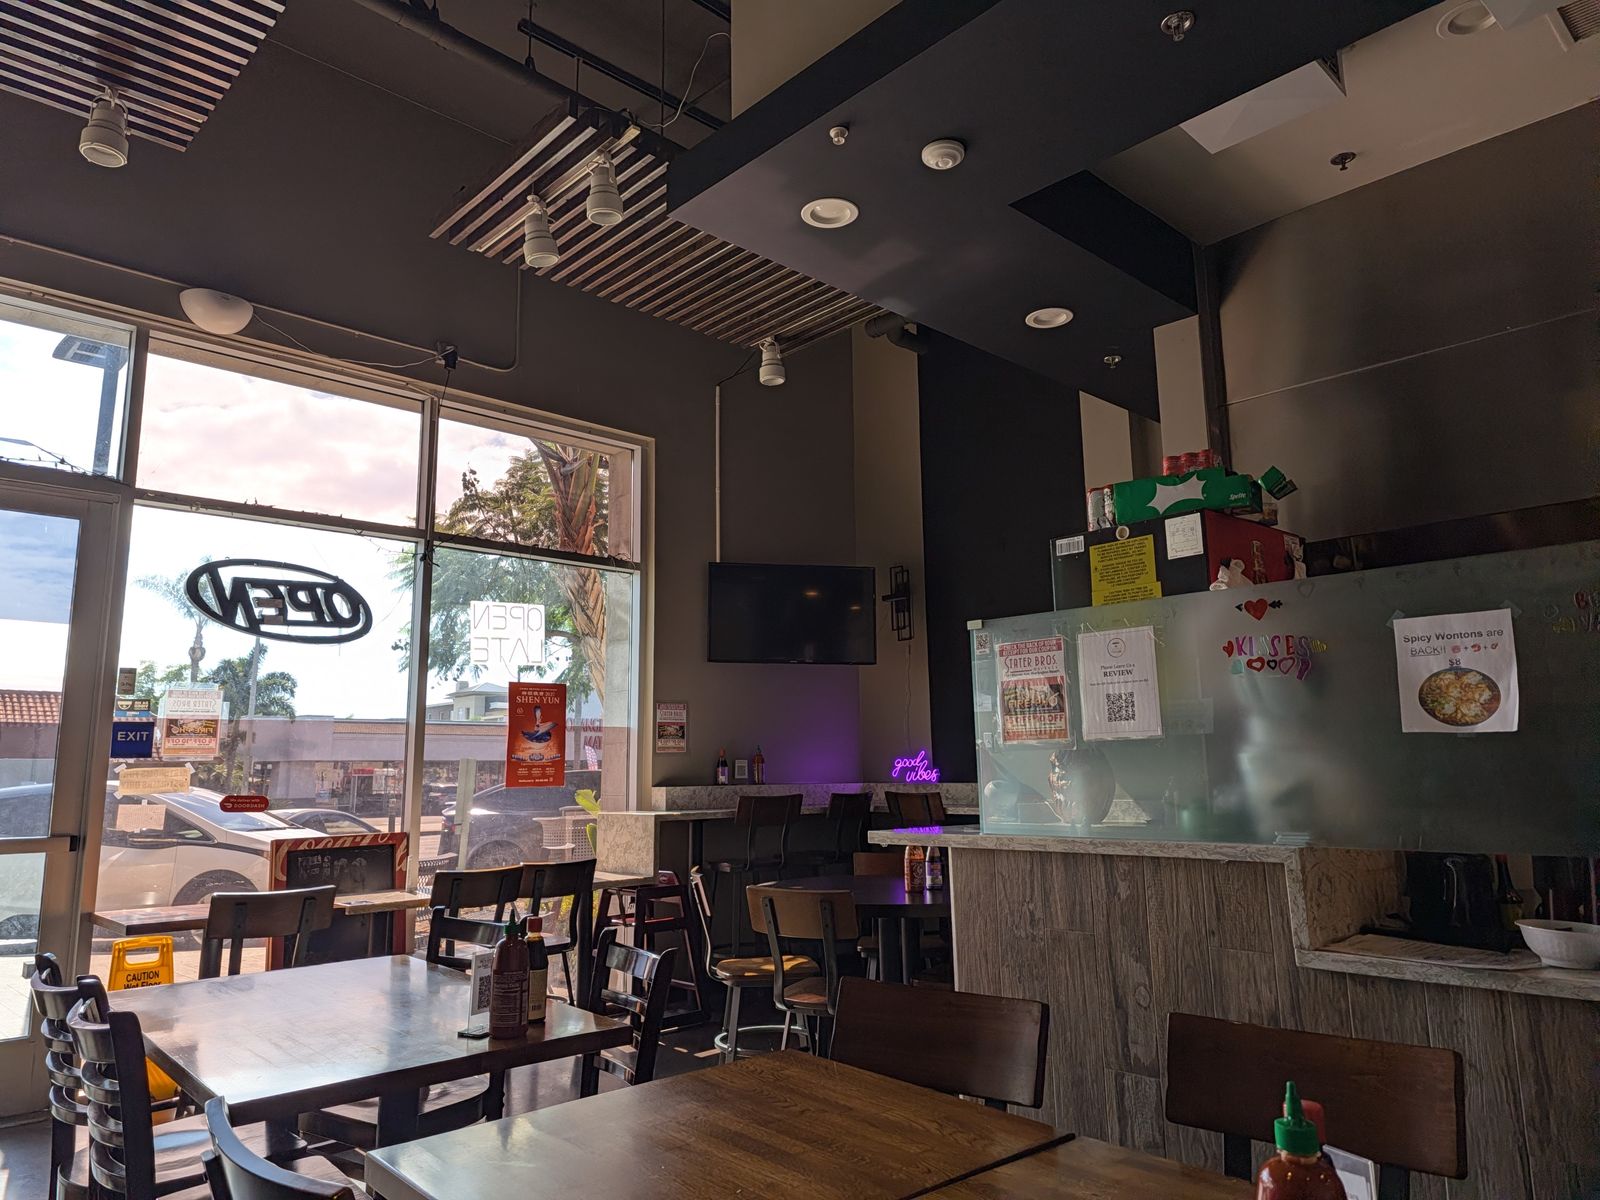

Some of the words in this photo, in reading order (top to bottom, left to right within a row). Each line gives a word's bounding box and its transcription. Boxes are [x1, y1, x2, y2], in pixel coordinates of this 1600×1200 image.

[1229, 492, 1247, 501] Sprite
[1403, 634, 1432, 644] Spicy
[1435, 630, 1483, 641] Wontons
[1486, 629, 1504, 637] are
[1235, 635, 1311, 657] KISSES
[1410, 645, 1447, 656] BACK!!
[1004, 655, 1032, 673] STATER
[1035, 654, 1058, 666] BROS.
[1449, 658, 1461, 667] $8
[1103, 669, 1134, 678] REVIEW
[516, 695, 540, 704] SHEN
[542, 696, 560, 704] YUN
[1047, 713, 1064, 723] OFF
[117, 731, 149, 741] EXIT
[892, 751, 926, 777] good
[905, 760, 940, 782] vibes
[126, 970, 160, 983] CAUTION
